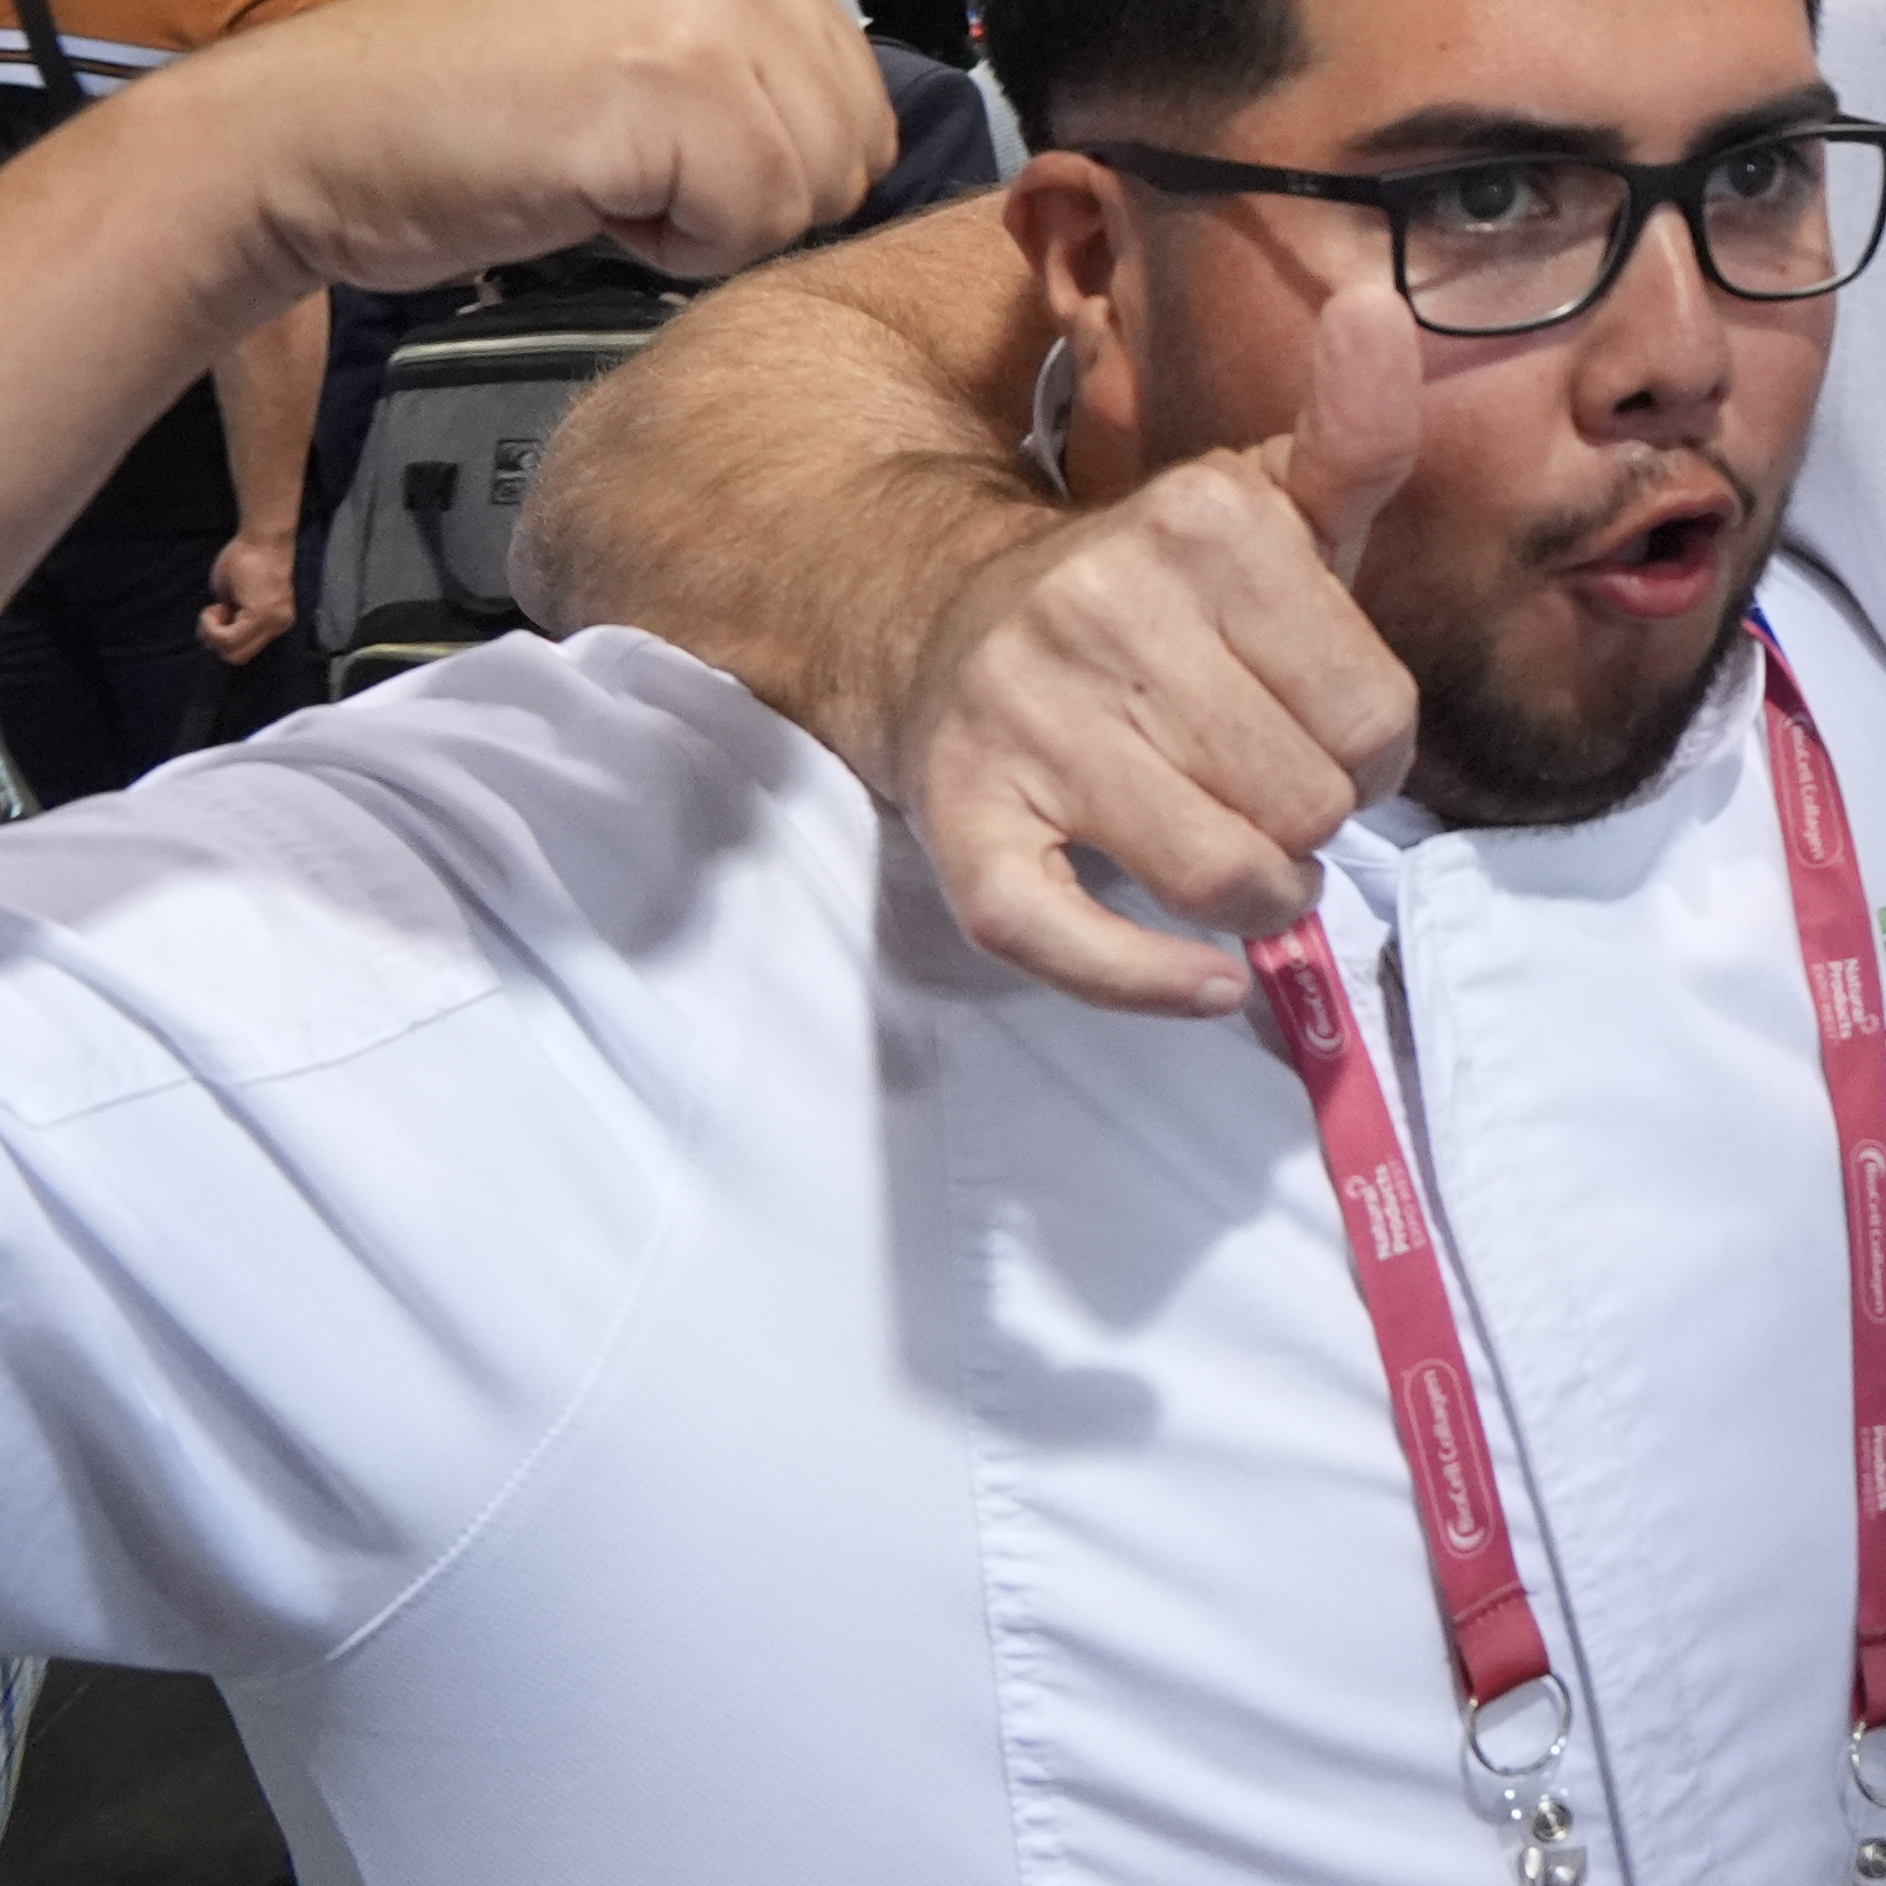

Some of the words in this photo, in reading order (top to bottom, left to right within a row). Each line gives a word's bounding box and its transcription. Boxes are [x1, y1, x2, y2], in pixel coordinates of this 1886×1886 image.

[1797, 783, 1829, 861] Collagen
[1827, 960, 1852, 1039] Products
[1844, 957, 1866, 1023] Natural
[1356, 1184, 1396, 1261] Natural
[1368, 1163, 1412, 1254] Products
[1868, 1229, 1885, 1314] Collagen
[1417, 1367, 1462, 1463] Collagen
